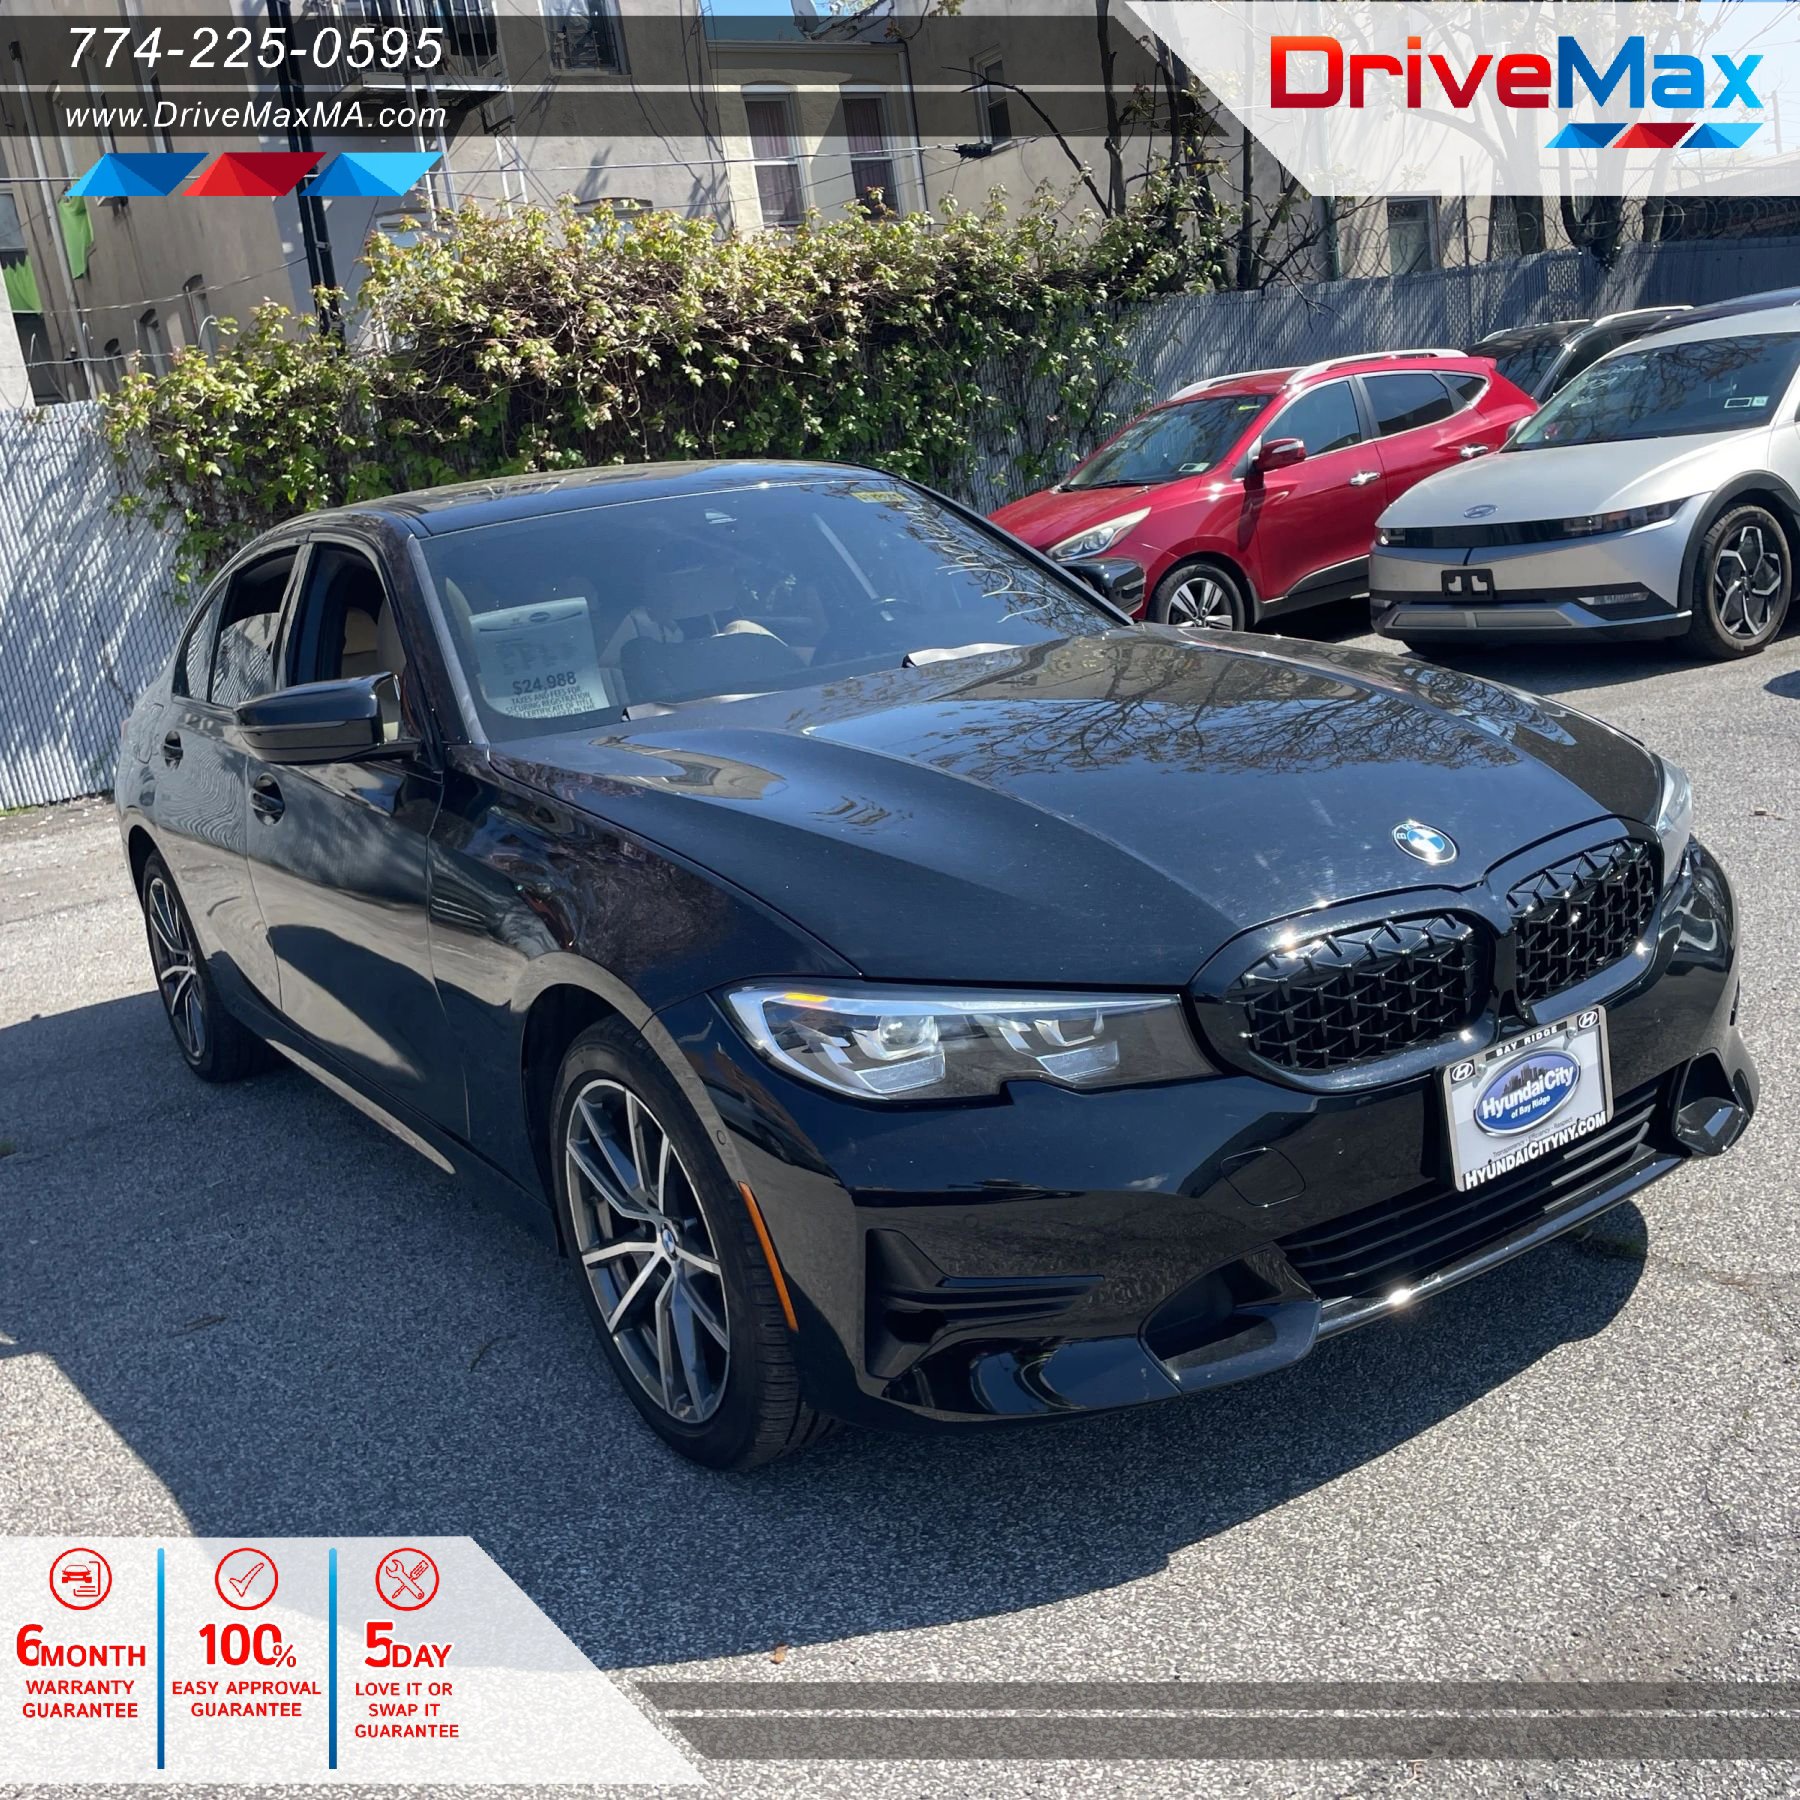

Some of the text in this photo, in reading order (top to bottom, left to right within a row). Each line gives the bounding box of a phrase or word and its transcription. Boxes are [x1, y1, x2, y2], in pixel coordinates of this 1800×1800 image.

[512, 671, 577, 696] $24,988
[1495, 1025, 1558, 1057] BAY RIDGE
[1511, 1095, 1551, 1119] of Bay Ridge
[1463, 1110, 1607, 1190] HYUNDAICITYNY.COM
